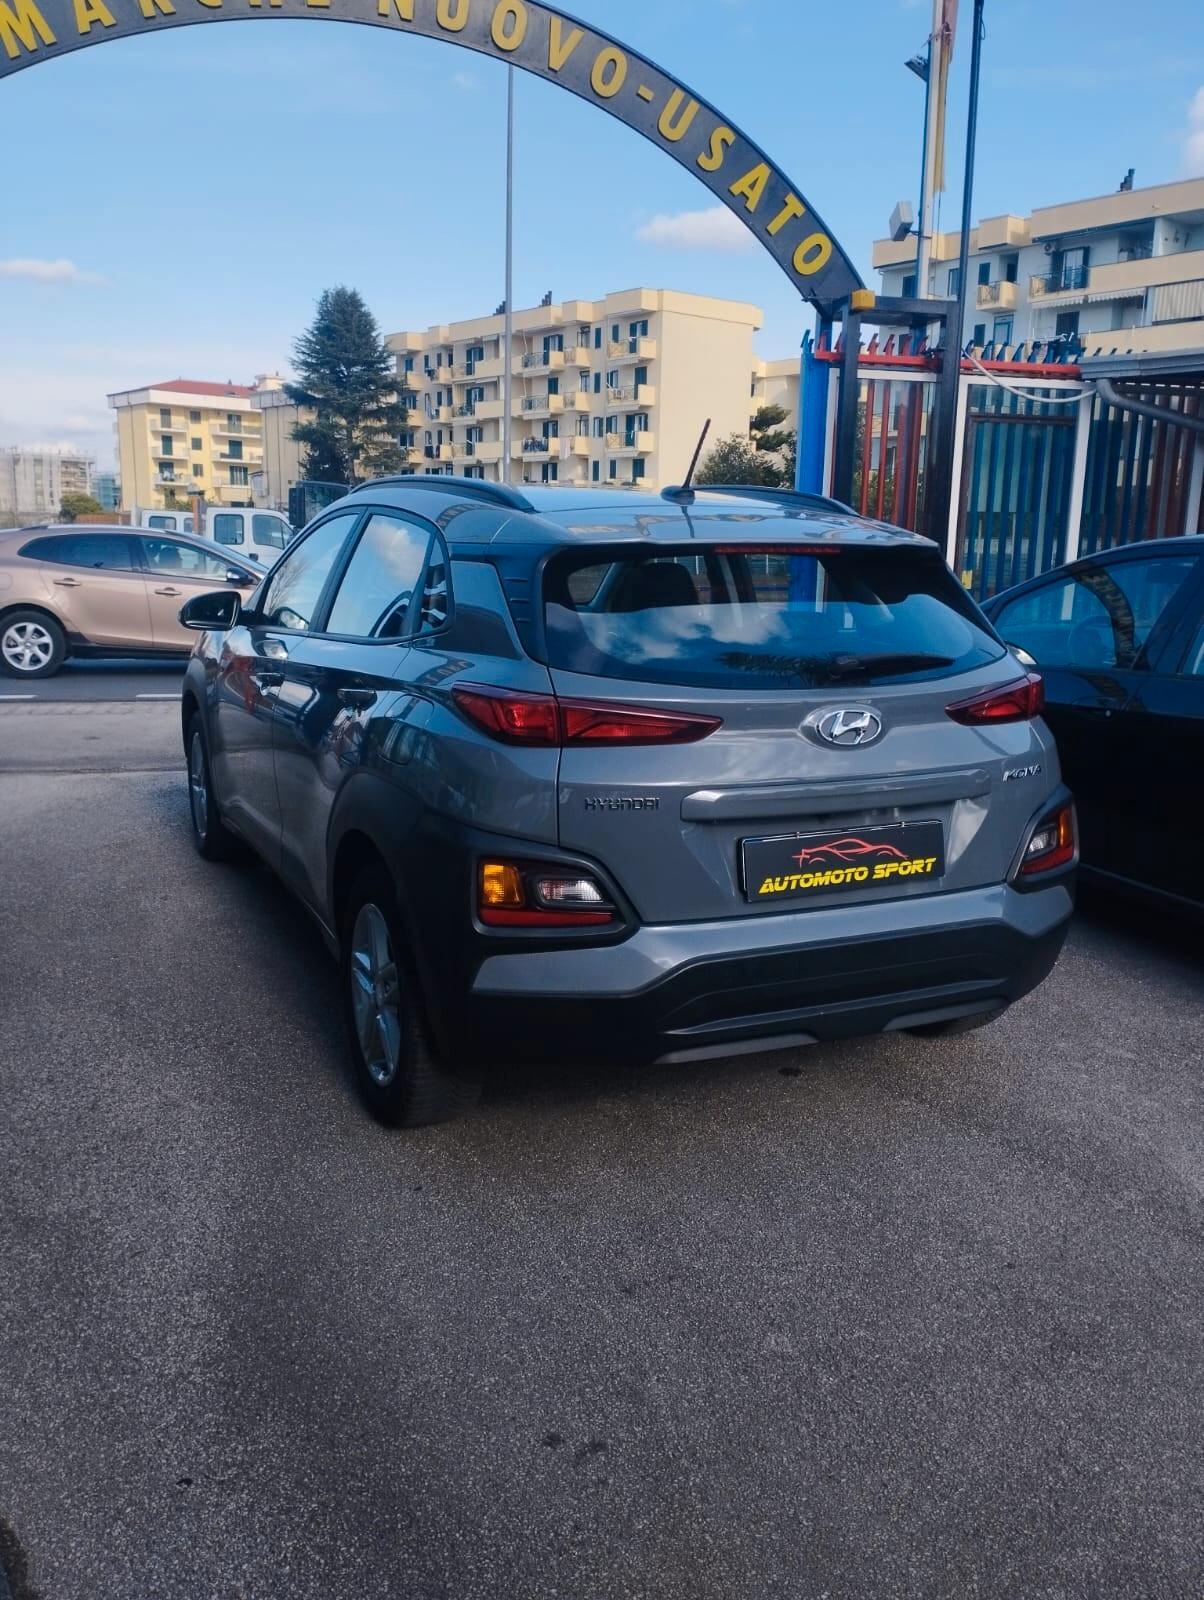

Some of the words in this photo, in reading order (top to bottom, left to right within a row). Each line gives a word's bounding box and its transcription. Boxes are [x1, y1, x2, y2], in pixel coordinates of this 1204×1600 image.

[584, 797, 660, 811] HYUNDAI
[759, 865, 869, 894] AUTOMOTO
[872, 858, 936, 879] SPORT
